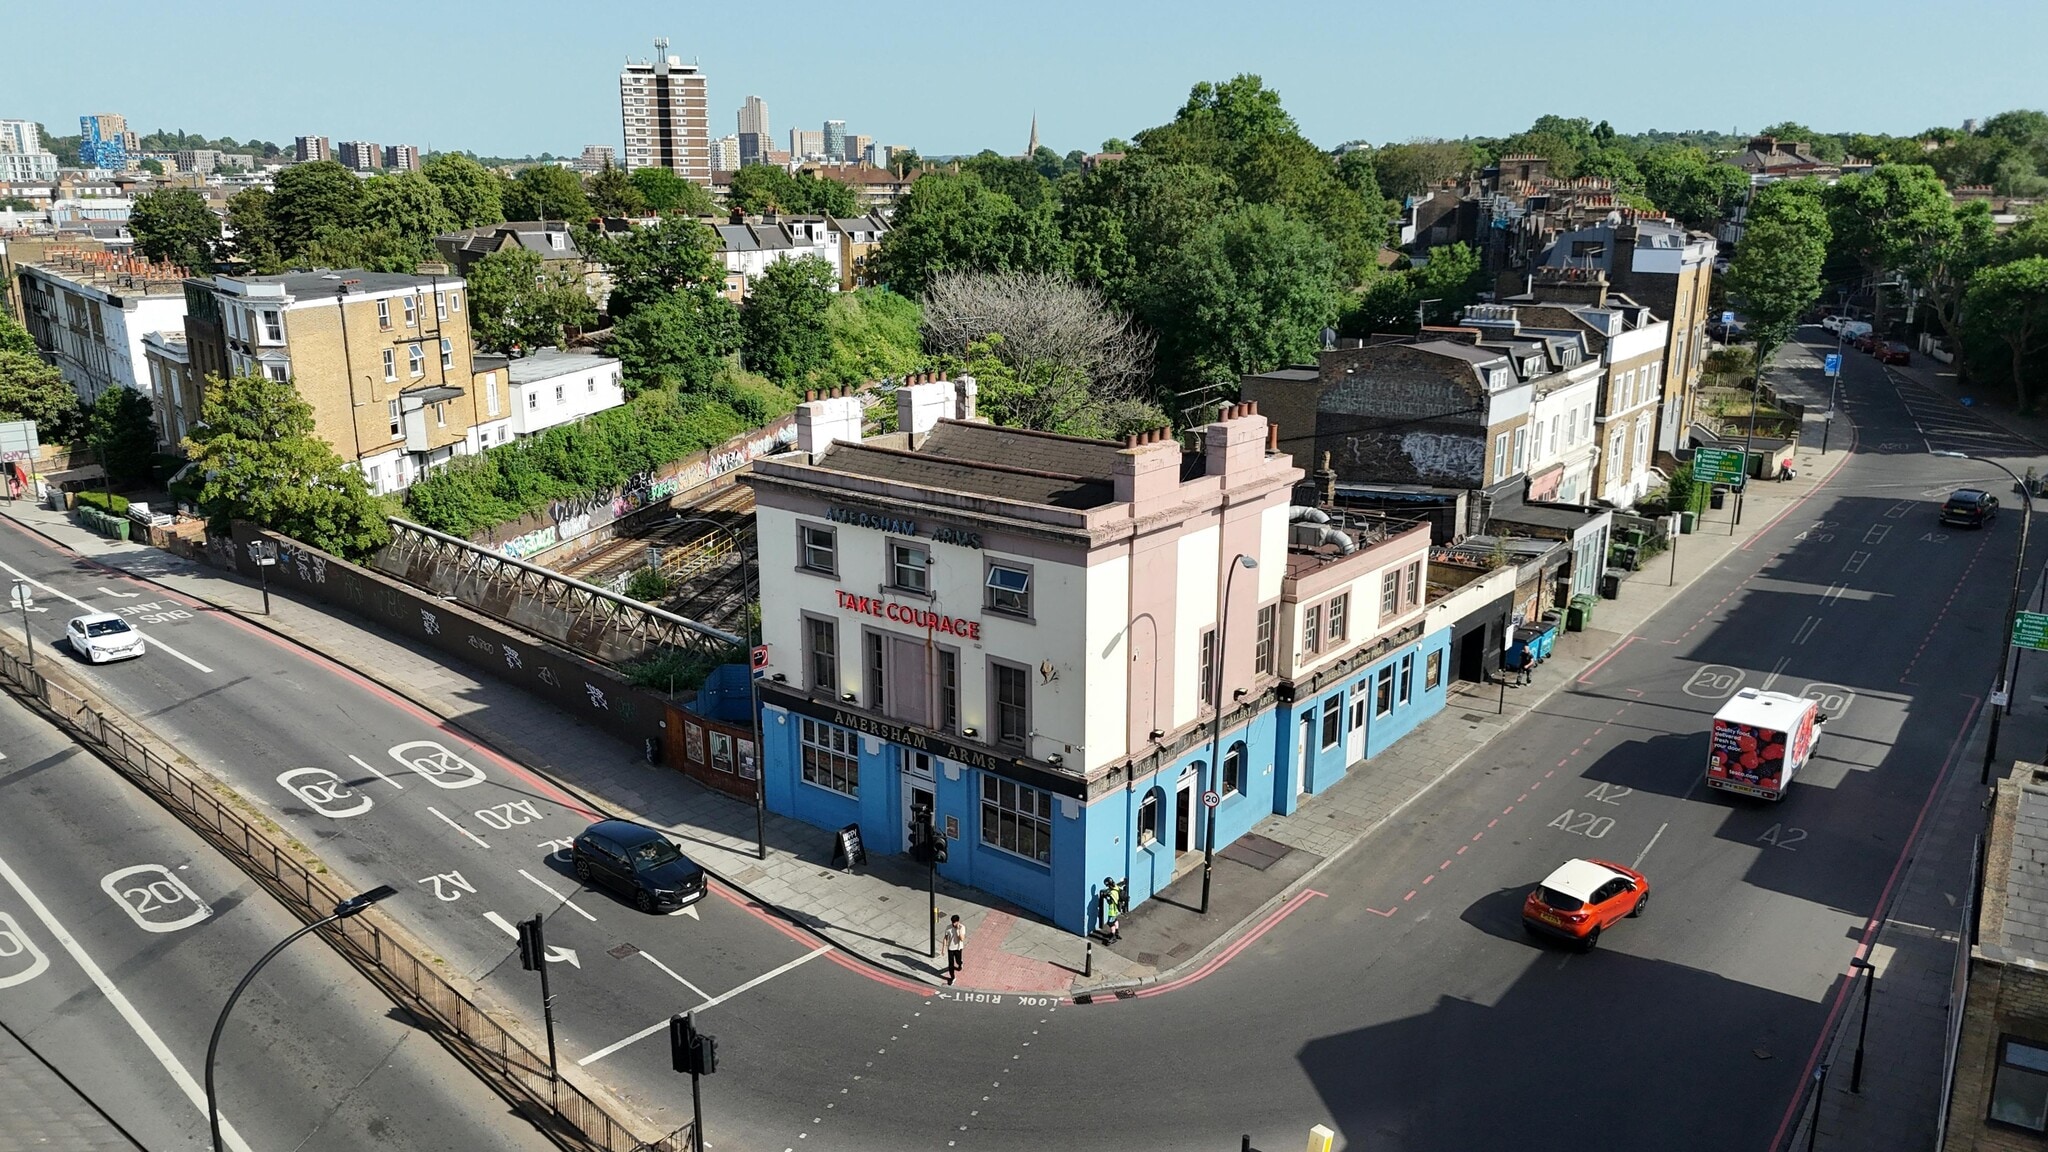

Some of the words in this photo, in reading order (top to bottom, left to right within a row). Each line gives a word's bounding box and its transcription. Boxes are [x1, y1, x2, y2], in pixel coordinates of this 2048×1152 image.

[824, 506, 916, 537] AMERSHAM
[932, 526, 982, 549] ARMS
[1920, 532, 1950, 545] A2
[113, 599, 182, 616] LANE
[139, 609, 194, 624] BUS
[834, 590, 883, 618] TAKE
[886, 603, 981, 641] COURAGE
[1694, 671, 1734, 690] 20
[834, 710, 928, 749] AMERSHAM
[947, 745, 996, 770] ARMS
[1715, 726, 1736, 735] Quality
[1715, 732, 1741, 740] delivered
[412, 752, 464, 775] 20
[1729, 769, 1759, 780] tesco.com
[299, 779, 352, 803] 20
[1205, 794, 1218, 804] 20
[1584, 781, 1634, 806] A2
[474, 799, 544, 830] A20
[1546, 808, 1616, 839] A20
[1756, 822, 1809, 851] A2
[123, 880, 185, 914] 20
[418, 870, 478, 902] A2
[0, 930, 24, 957] 0
[952, 992, 1002, 1004] RIGHT
[1018, 995, 1059, 1007] LOOK
